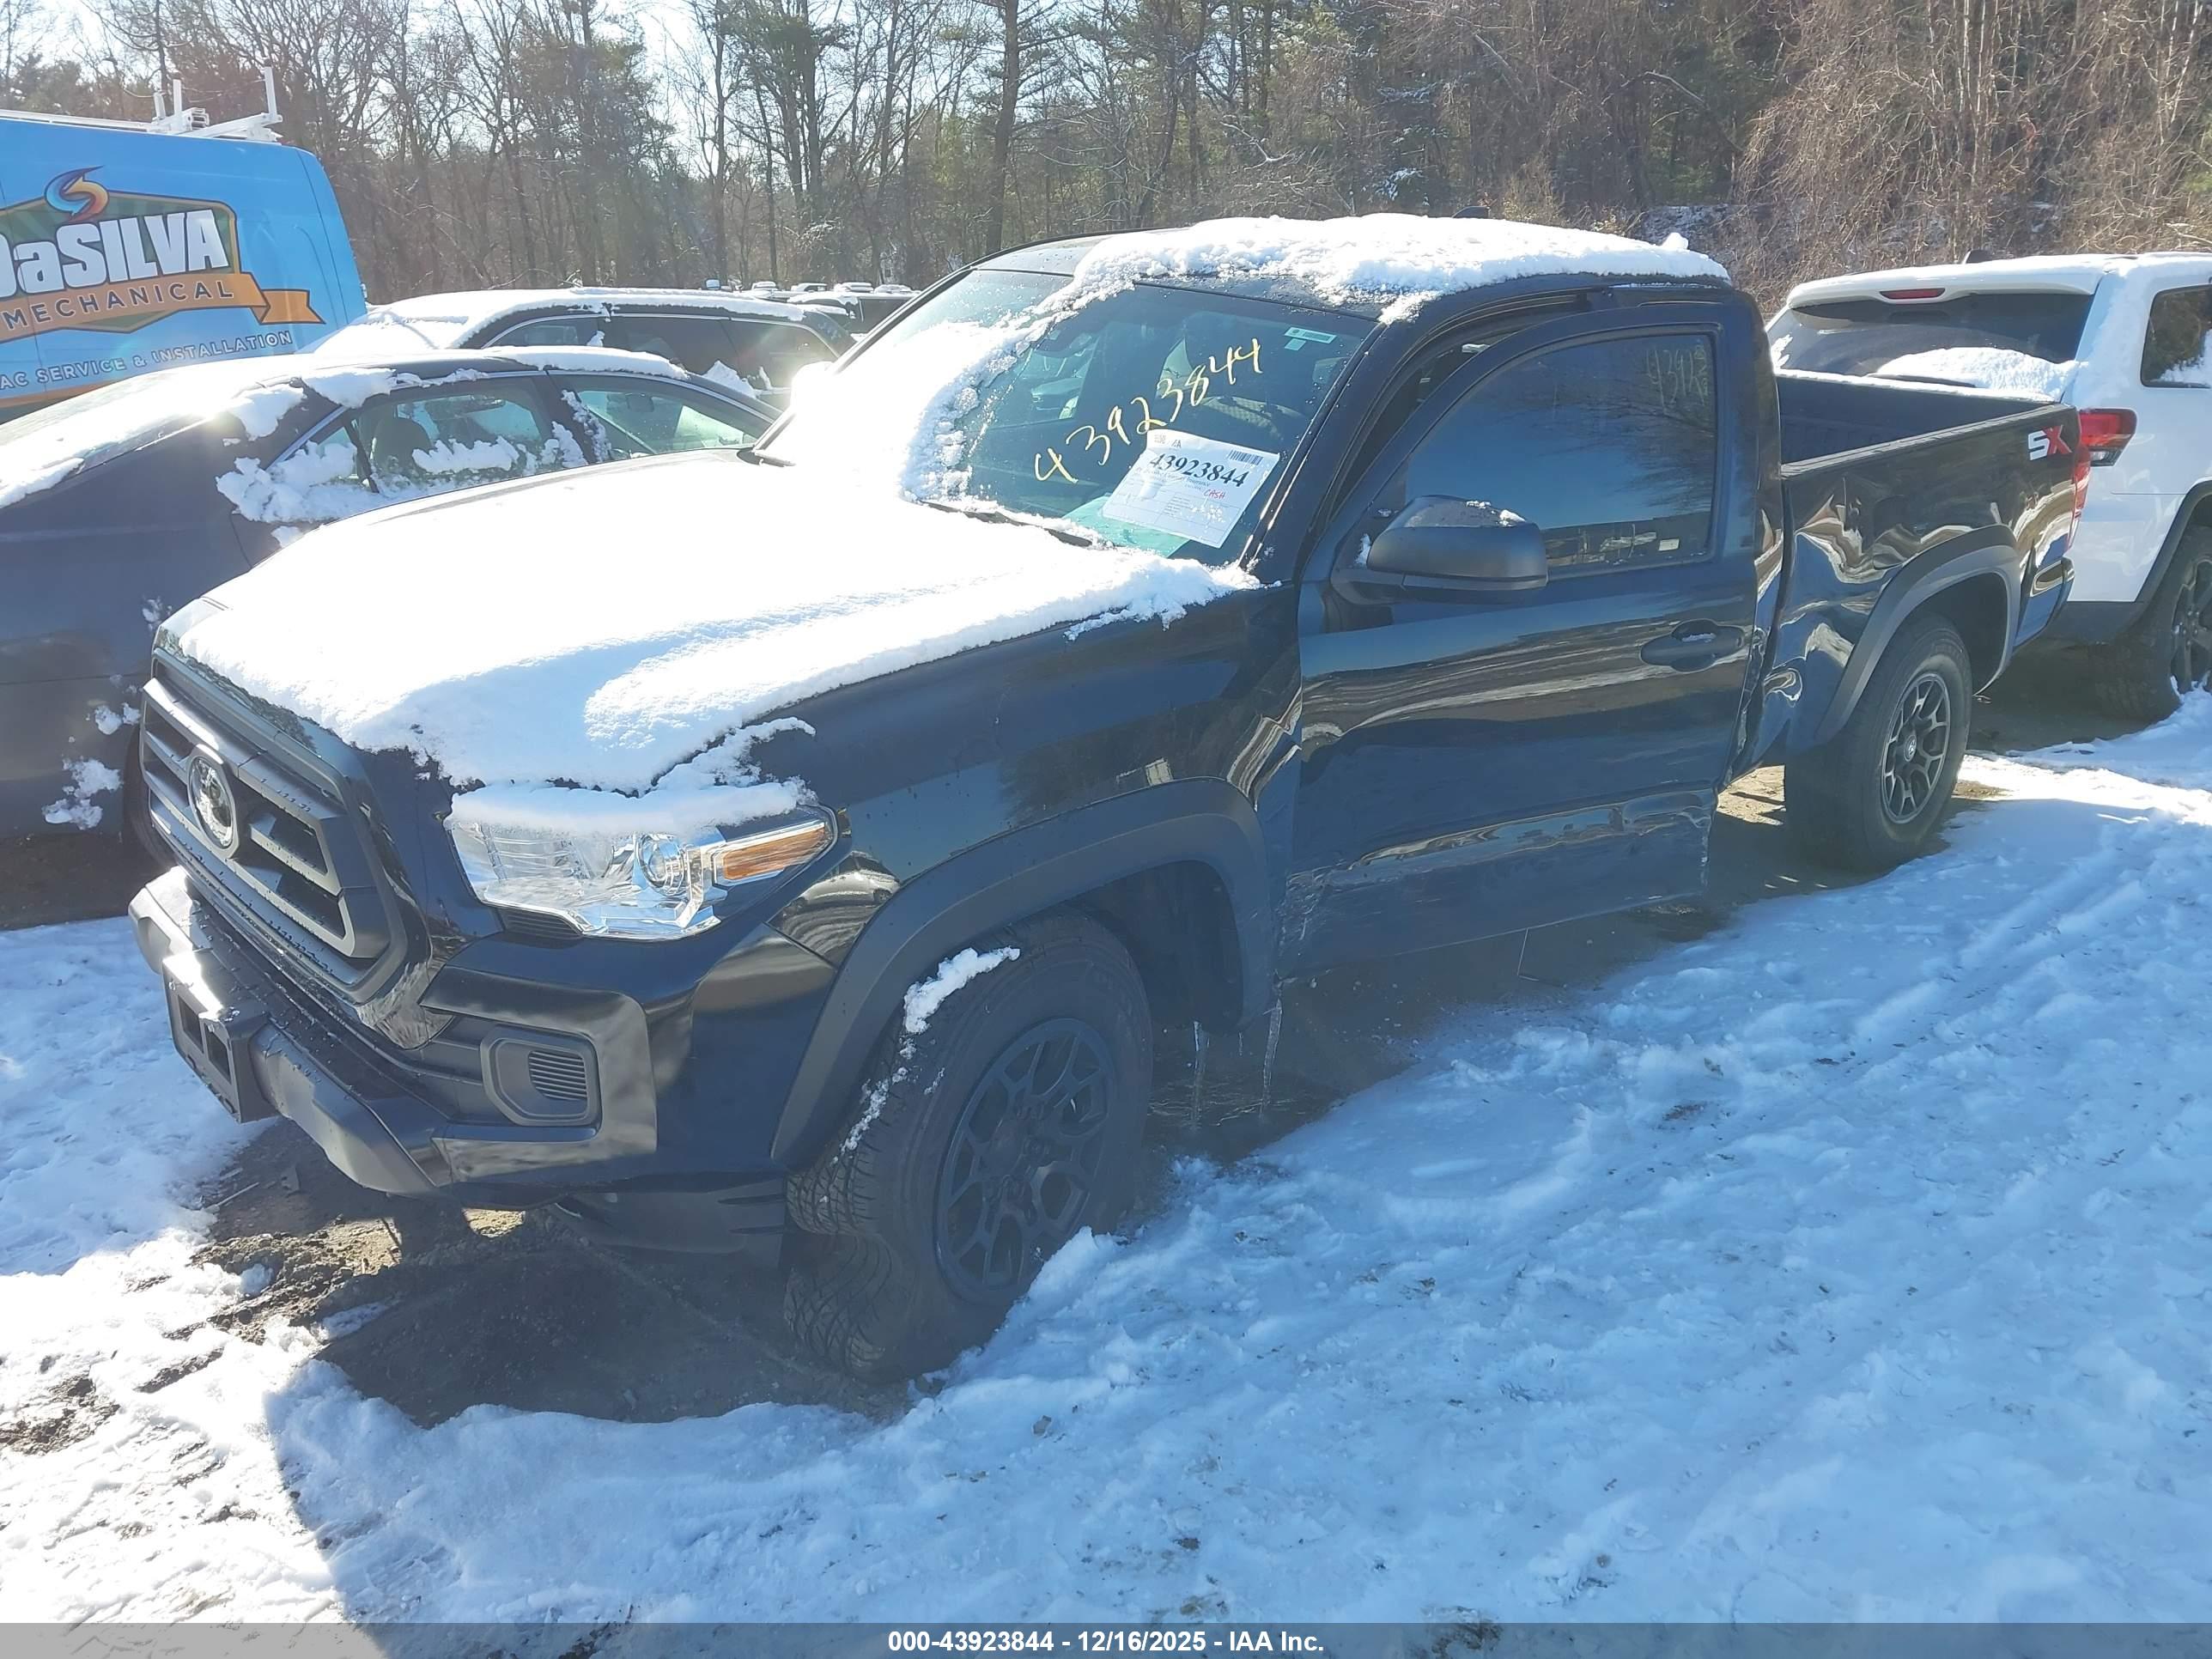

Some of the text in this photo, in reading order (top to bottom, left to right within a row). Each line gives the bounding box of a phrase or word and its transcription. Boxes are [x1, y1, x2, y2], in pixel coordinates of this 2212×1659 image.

[2, 280, 234, 331] MECHANICAL
[35, 356, 126, 384] SERVICE
[132, 354, 147, 368] &
[151, 330, 293, 364] INSTALLATION
[1035, 337, 1263, 483] 43923844
[2027, 424, 2072, 461] SX
[1149, 453, 1249, 488] 43923844
[1203, 489, 1226, 500] CASH
